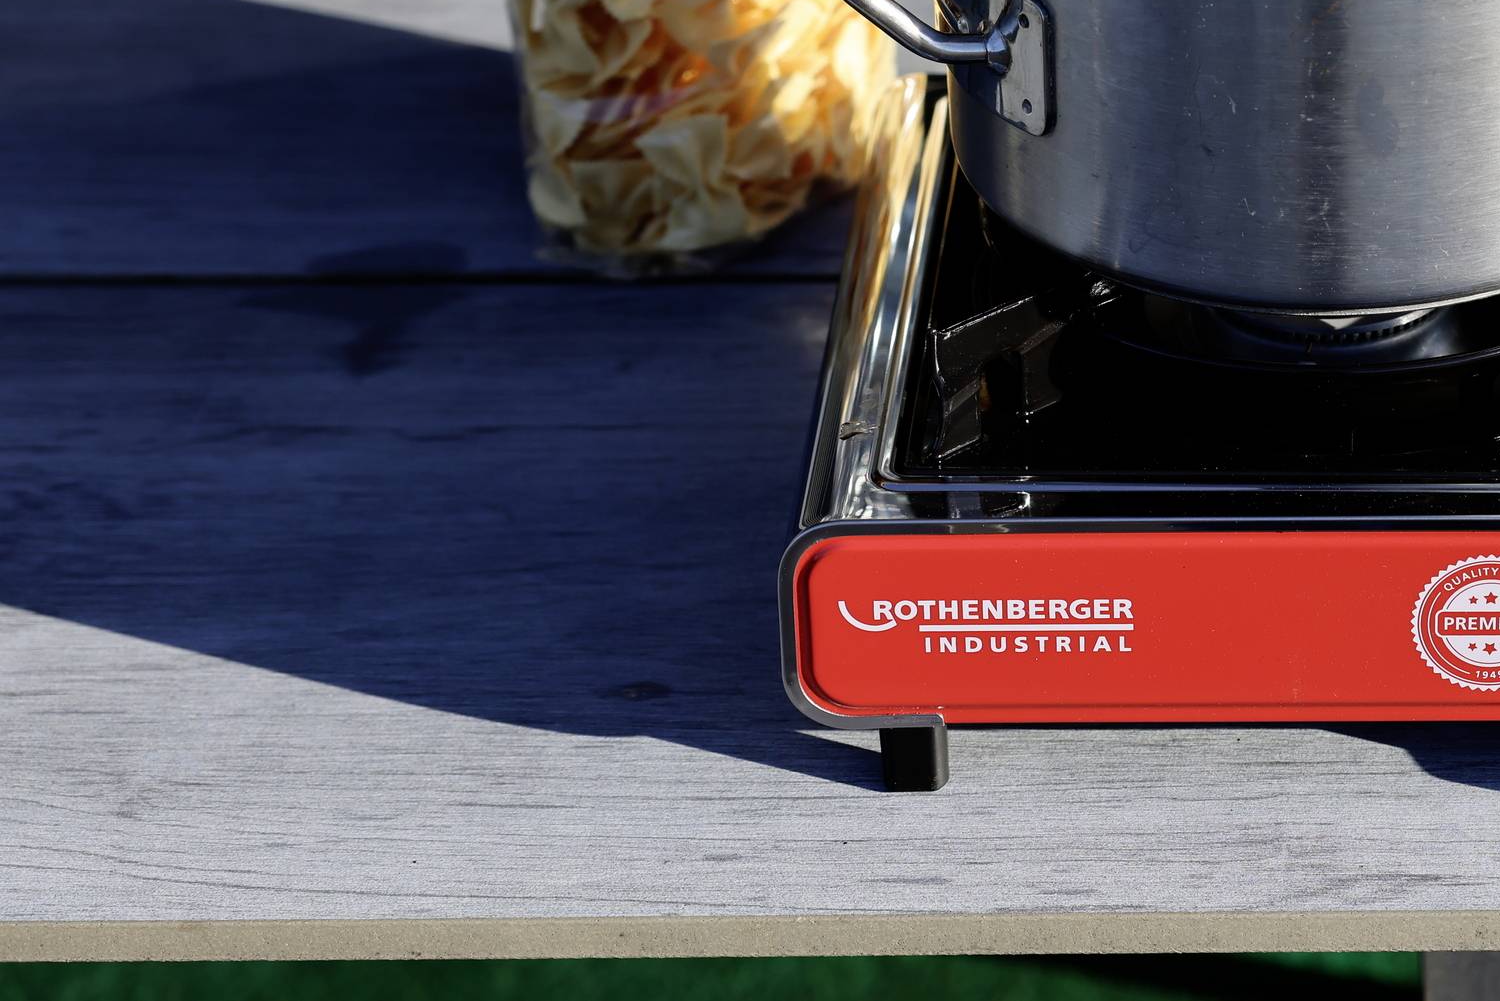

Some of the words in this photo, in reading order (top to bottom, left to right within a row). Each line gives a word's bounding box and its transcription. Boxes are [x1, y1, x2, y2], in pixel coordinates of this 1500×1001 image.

[1443, 567, 1500, 592] QUALITY
[873, 598, 1134, 621] ROTHENBERGER
[924, 635, 1132, 653] INDUSTRIAL
